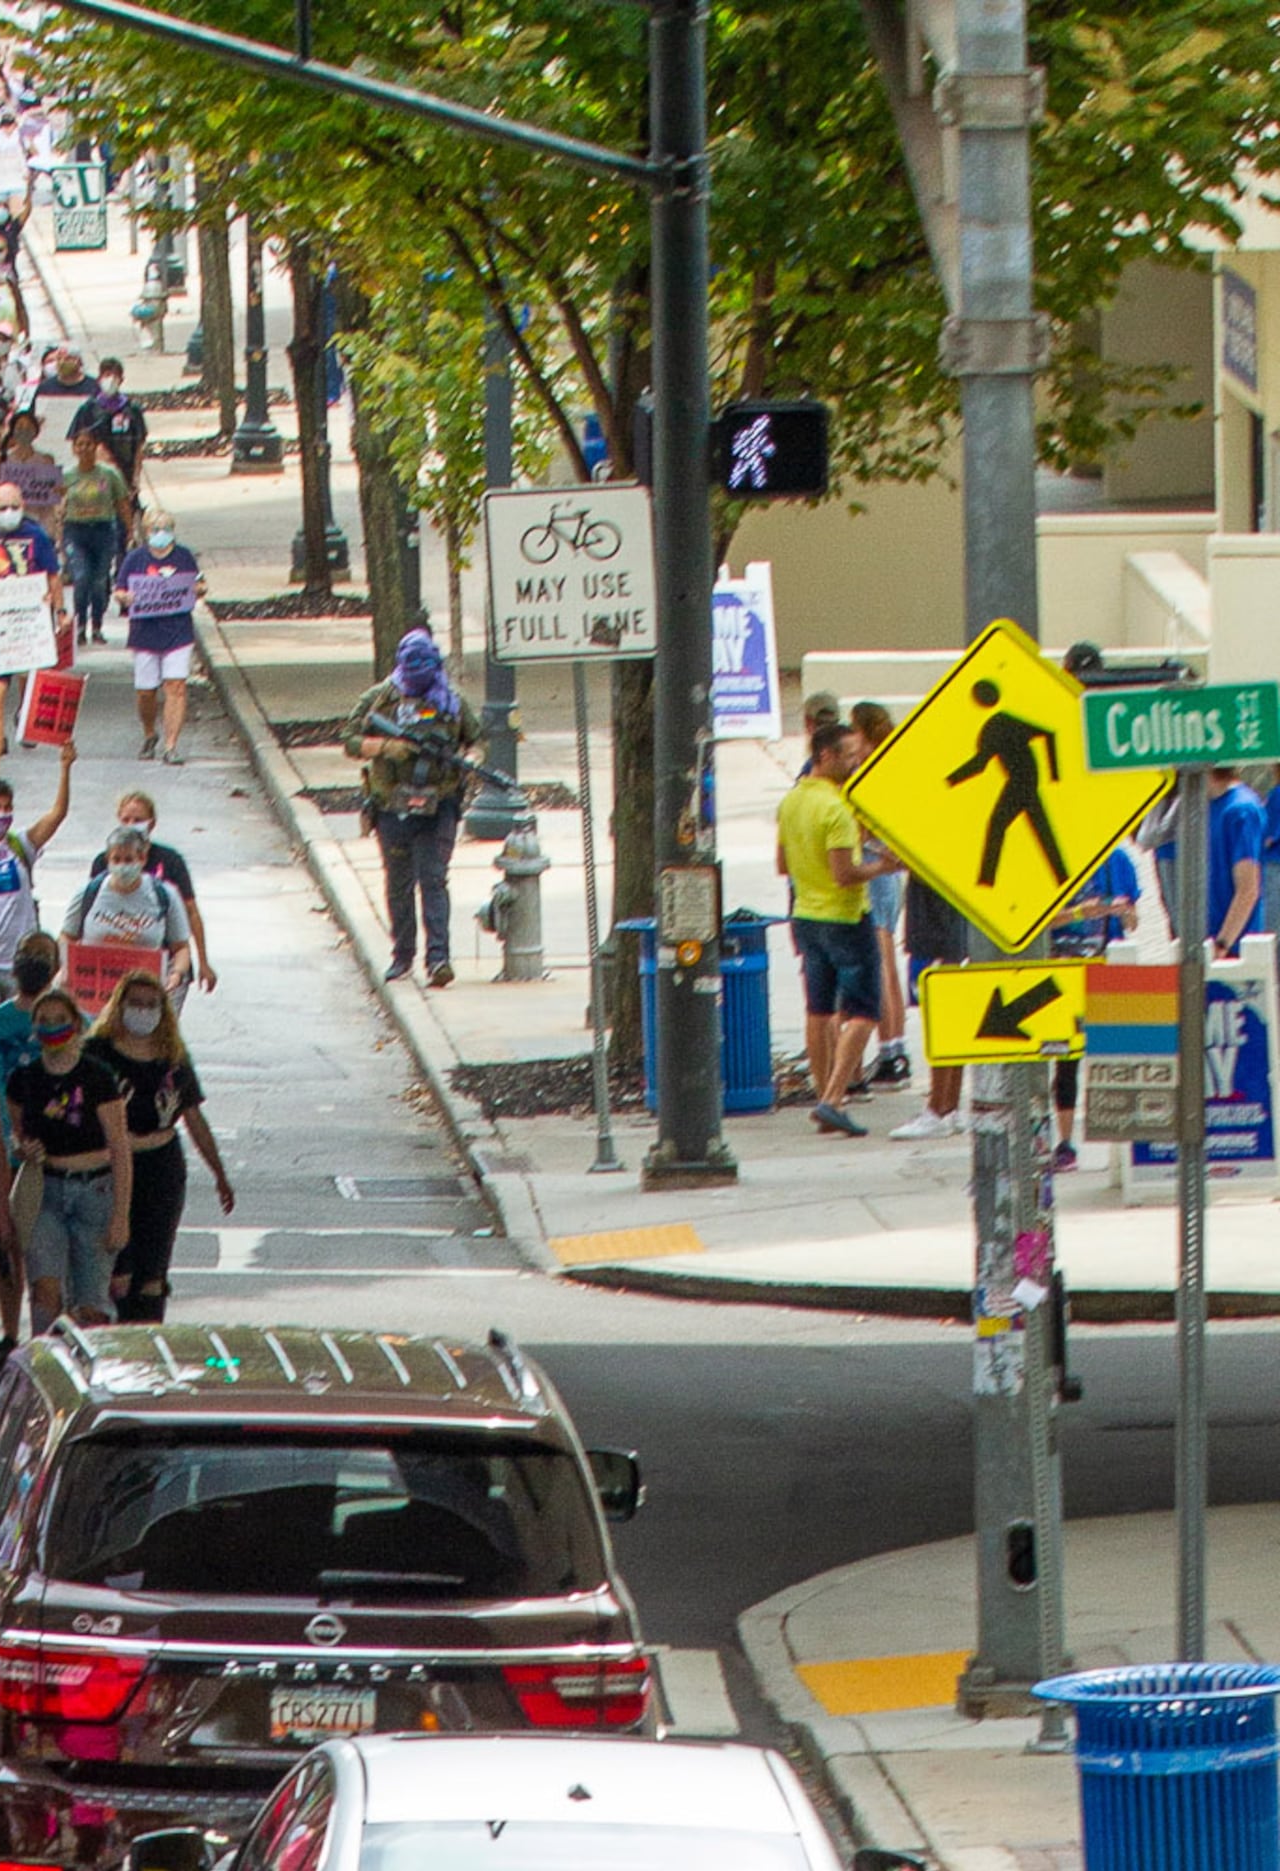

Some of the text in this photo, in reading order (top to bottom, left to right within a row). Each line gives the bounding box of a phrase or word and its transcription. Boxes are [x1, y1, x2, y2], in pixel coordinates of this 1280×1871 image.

[515, 571, 632, 604] MAY USE
[505, 615, 567, 643] FULL
[1106, 701, 1225, 757] Collins
[1089, 1063, 1171, 1083] marta
